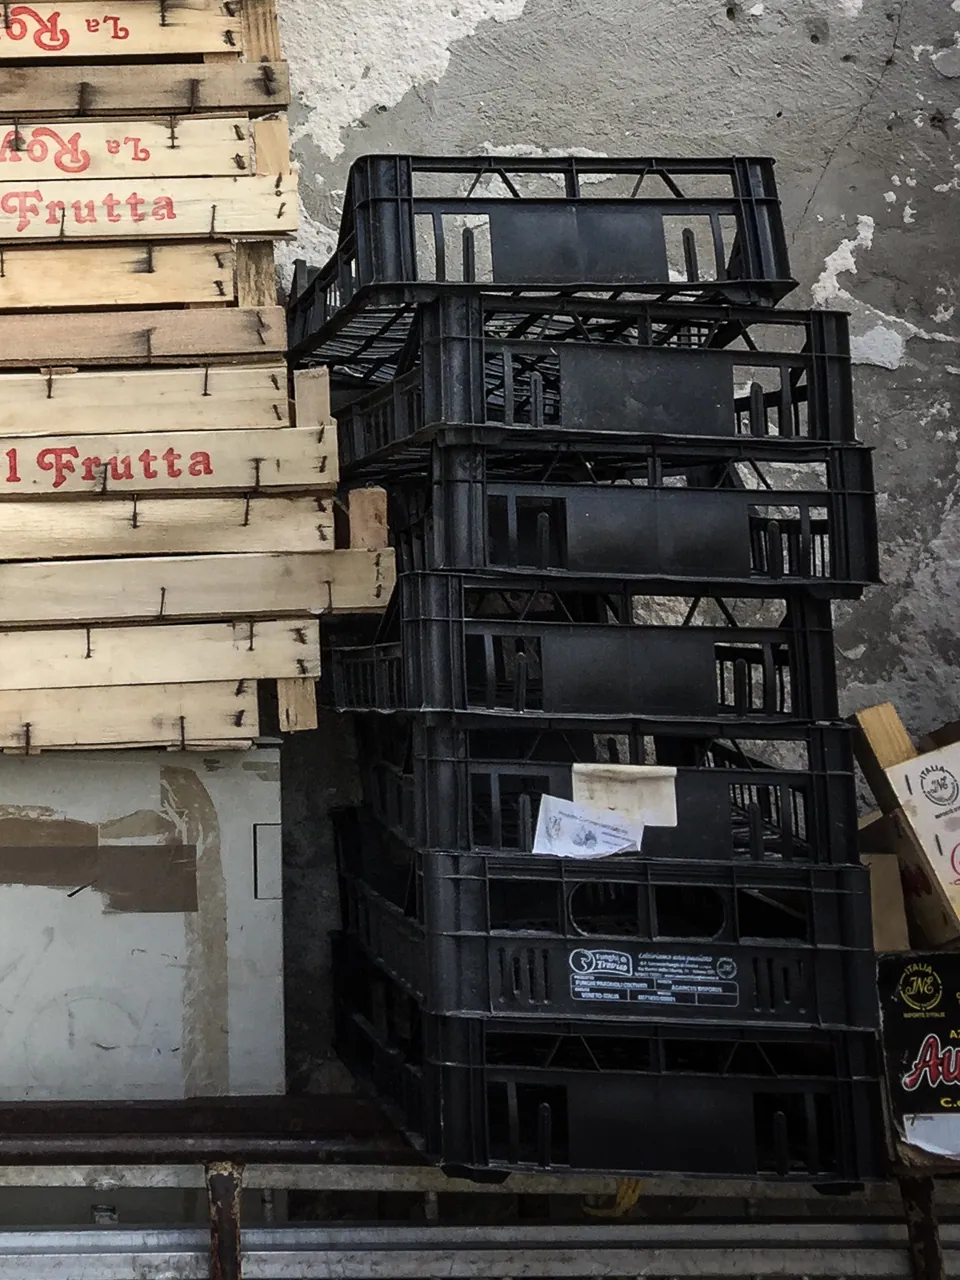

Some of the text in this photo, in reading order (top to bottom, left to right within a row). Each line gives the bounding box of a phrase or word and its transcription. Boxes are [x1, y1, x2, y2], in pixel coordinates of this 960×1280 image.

[85, 16, 133, 42] La
[107, 137, 152, 164] La
[0, 191, 178, 234] Frutta
[36, 447, 214, 490] Frutta
[919, 764, 947, 780] ITALIA
[904, 962, 933, 975] ITALIA
